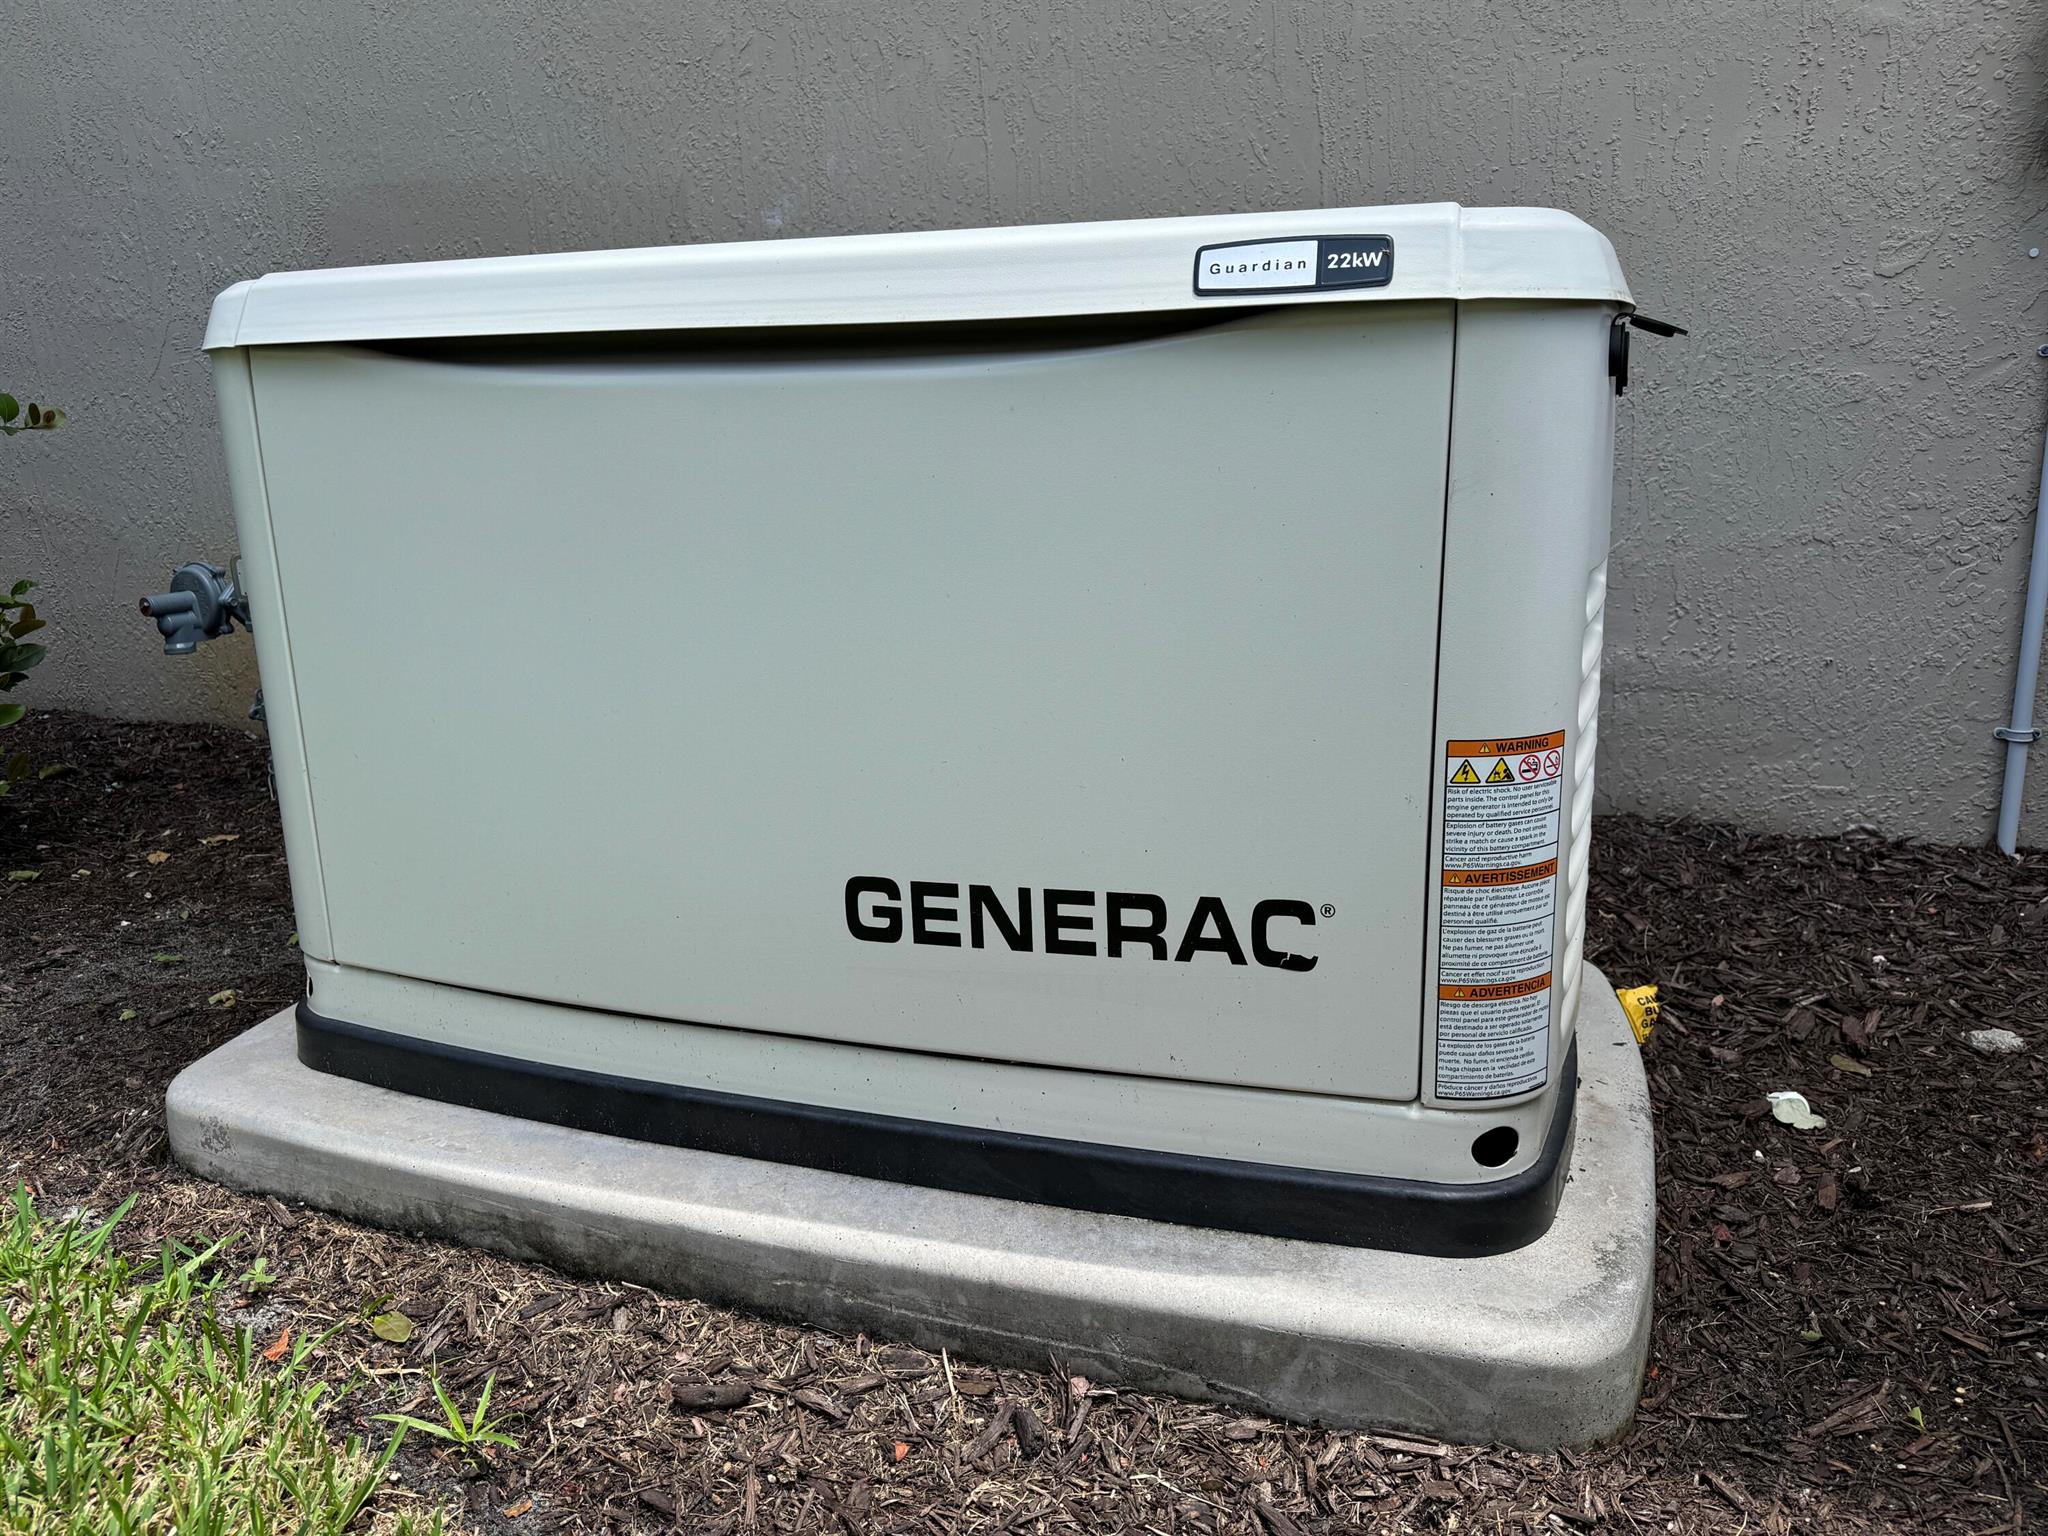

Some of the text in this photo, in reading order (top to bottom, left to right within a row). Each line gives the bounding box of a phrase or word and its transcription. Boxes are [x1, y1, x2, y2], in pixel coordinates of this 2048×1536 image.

[1209, 250, 1383, 275] Guardian 22kW
[1496, 738, 1549, 752] WARNING
[1520, 791, 1534, 800] panel
[1507, 800, 1531, 808] intended
[1486, 821, 1506, 829] battery
[1468, 830, 1486, 838] injury
[1520, 834, 1533, 842] spark
[1482, 854, 1518, 862] reproductive
[1465, 862, 1554, 883] AVERTISSEMENT
[1490, 901, 1519, 909] générateur
[845, 876, 1318, 972] GENERAC
[1504, 934, 1521, 942] graves
[1479, 952, 1507, 960] provoquer
[1470, 978, 1545, 997] ADVERTENCIA
[1502, 1006, 1519, 1014] pueda
[1507, 1011, 1532, 1021] generador
[1499, 1020, 1520, 1029] operado
[1493, 1040, 1508, 1048] gases
[1496, 1054, 1518, 1063] encienda
[1498, 1060, 1520, 1071] vecindad
